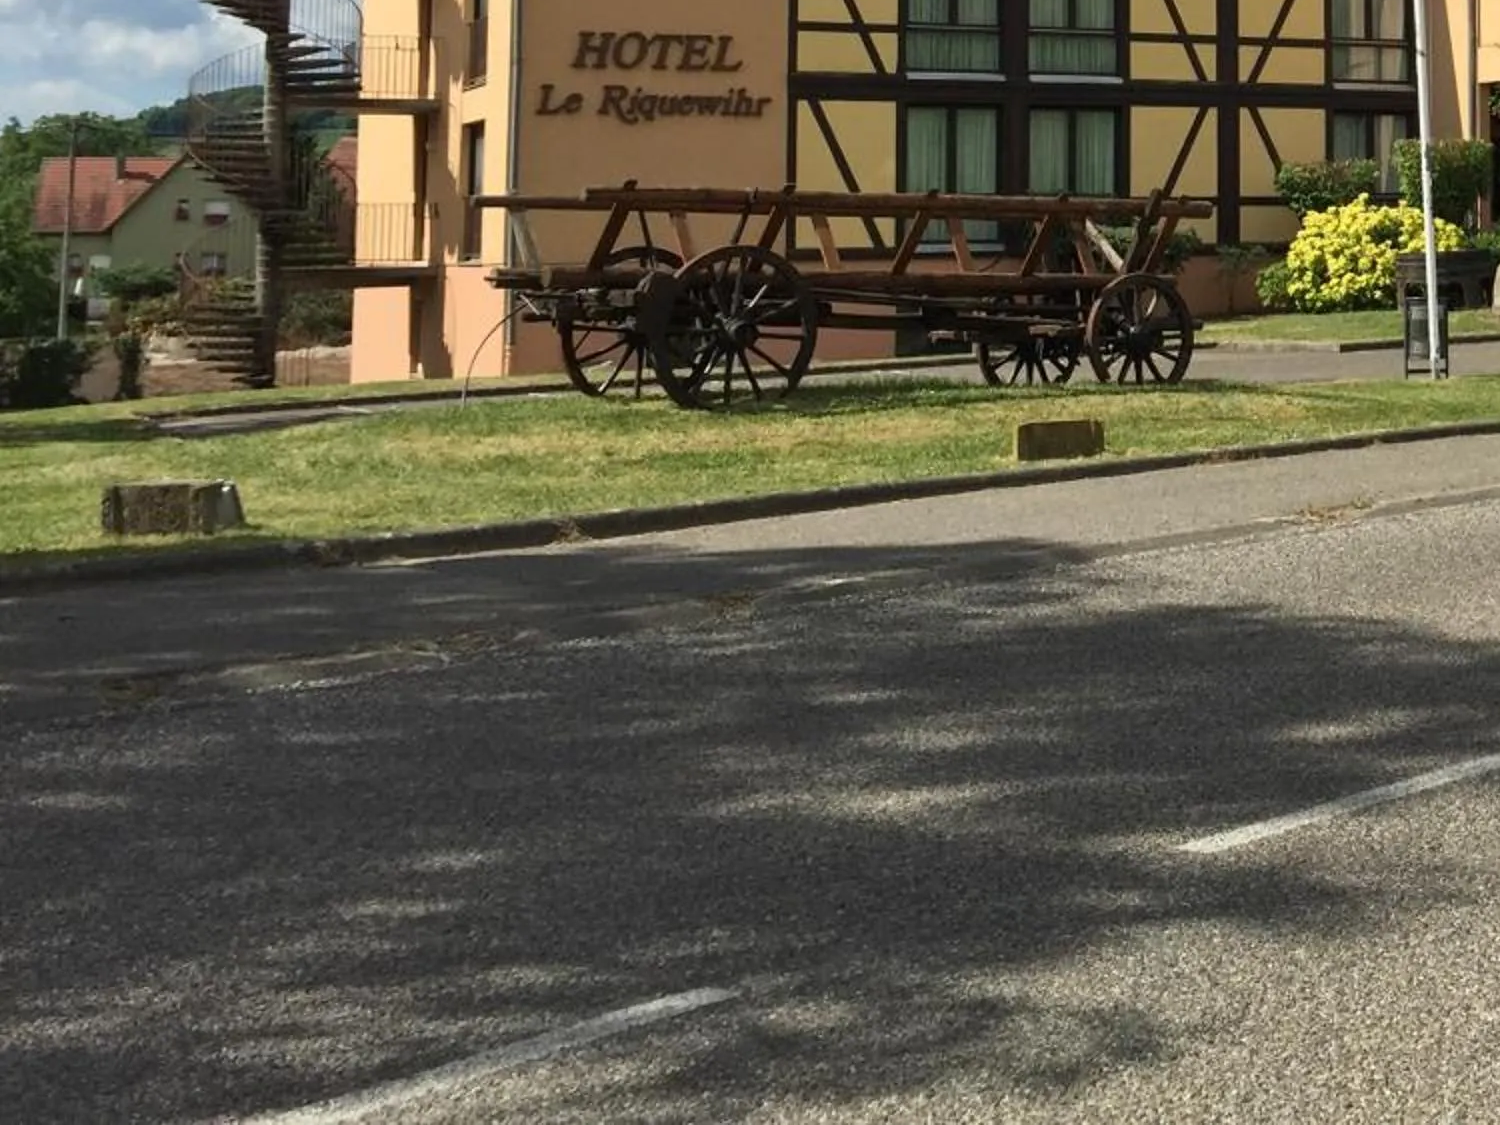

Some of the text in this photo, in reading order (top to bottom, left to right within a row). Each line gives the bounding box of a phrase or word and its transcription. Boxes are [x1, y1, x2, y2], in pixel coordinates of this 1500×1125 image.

[570, 31, 743, 72] HOTEL
[535, 83, 772, 125] Le Riquewihr
